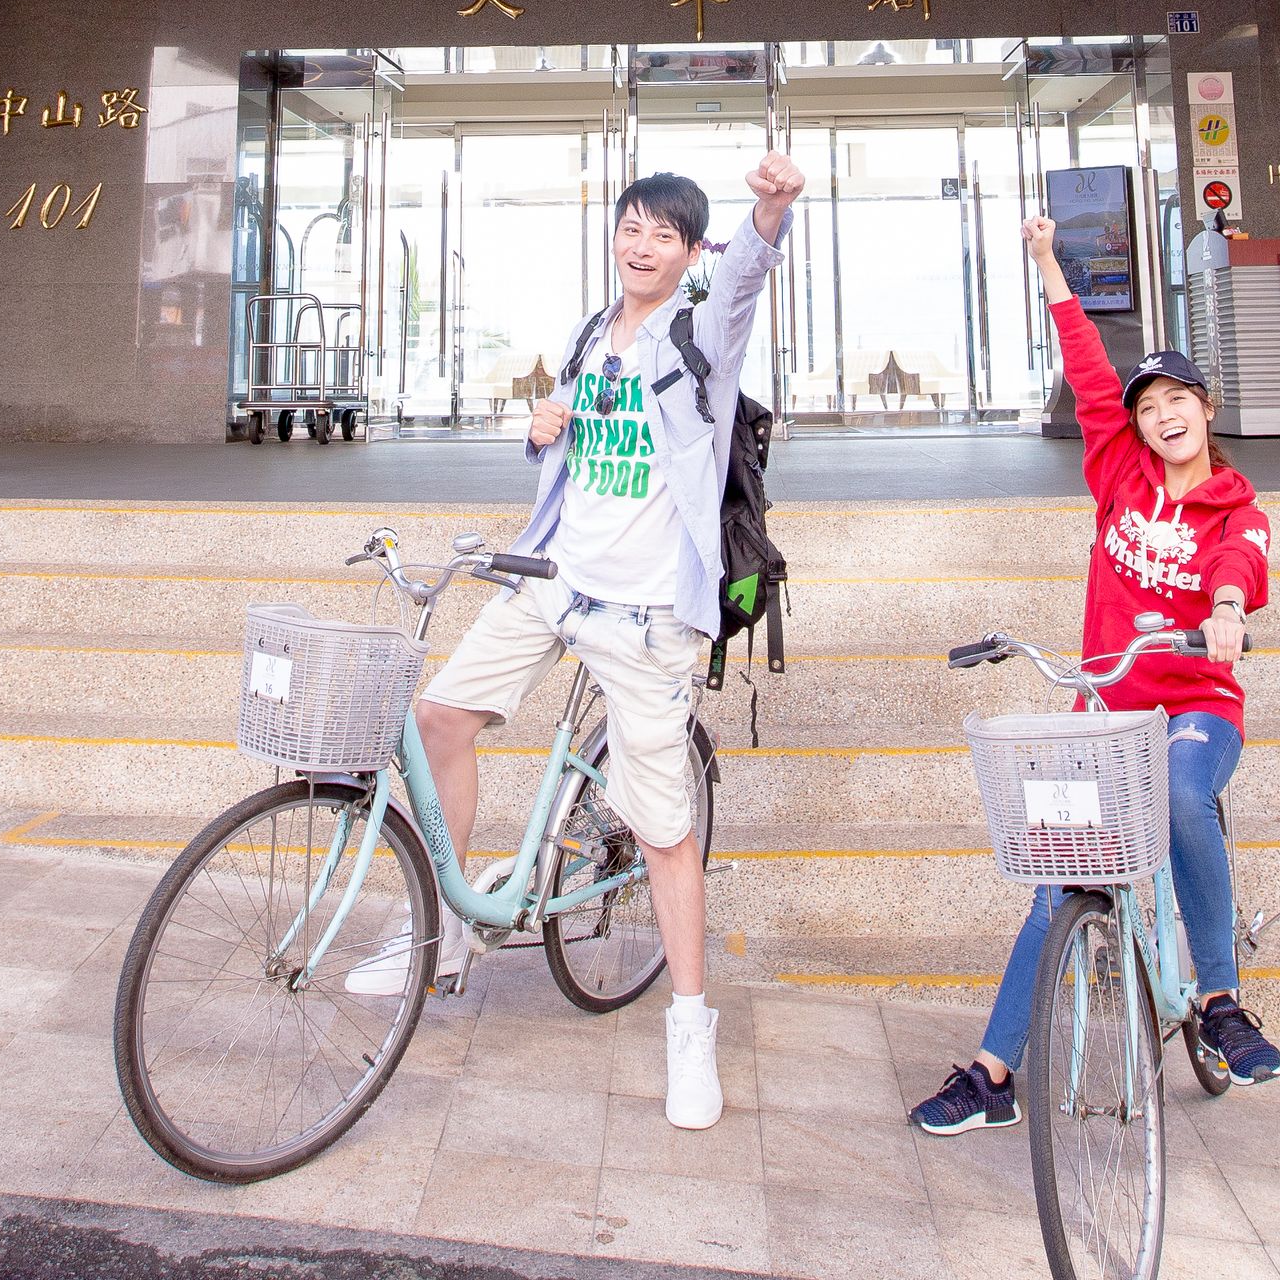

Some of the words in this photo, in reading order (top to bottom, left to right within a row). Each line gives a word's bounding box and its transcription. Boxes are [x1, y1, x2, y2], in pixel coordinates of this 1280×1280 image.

[1176, 20, 1197, 31] 101
[5, 181, 103, 230] 101
[574, 417, 655, 458] RIENDS
[583, 458, 651, 499] FOOD
[265, 684, 273, 694] 16
[1057, 810, 1070, 822] 12
